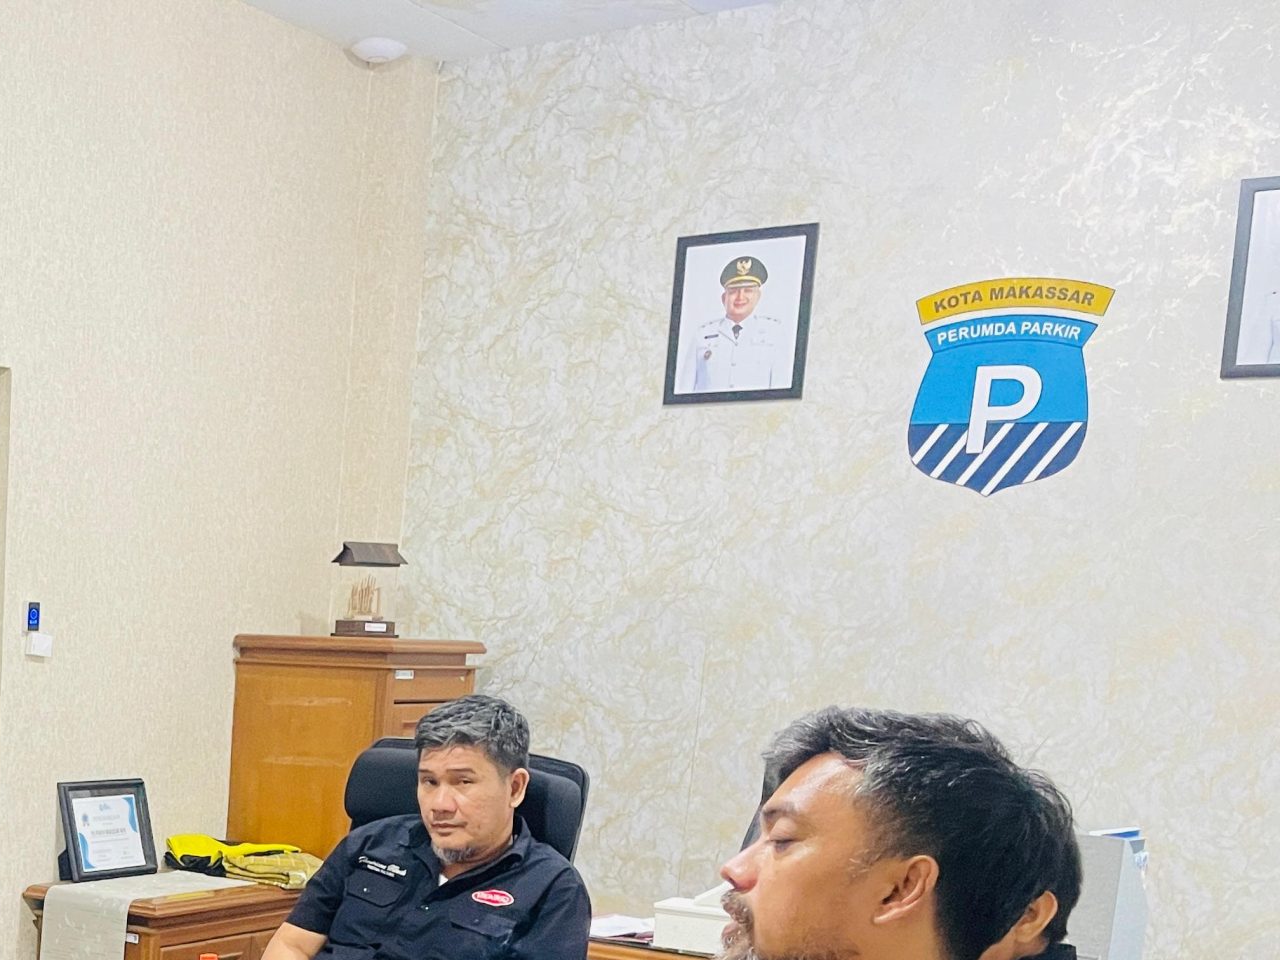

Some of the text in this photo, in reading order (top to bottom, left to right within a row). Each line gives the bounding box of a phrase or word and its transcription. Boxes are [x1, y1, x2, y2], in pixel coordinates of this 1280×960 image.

[933, 285, 1096, 314] KOTA MAKASSAR
[936, 321, 1082, 346] PERUMDA PARKIR
[965, 364, 1044, 455] P
